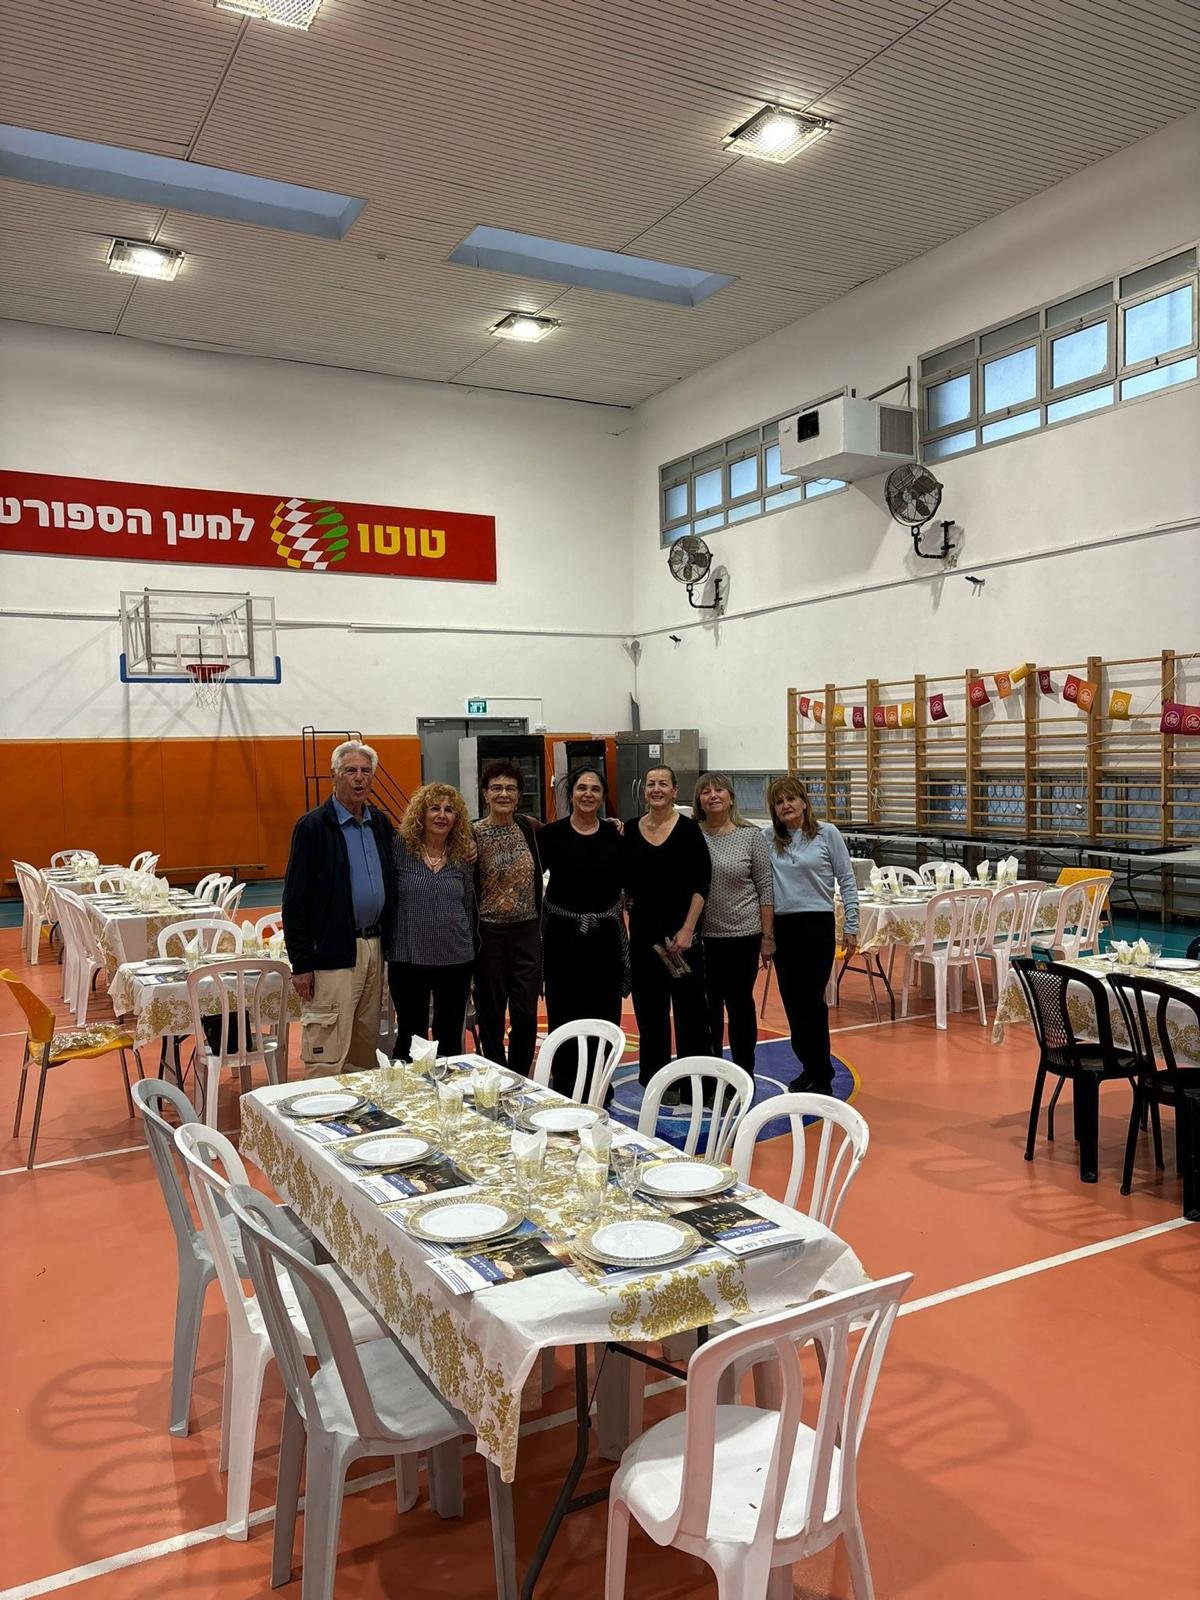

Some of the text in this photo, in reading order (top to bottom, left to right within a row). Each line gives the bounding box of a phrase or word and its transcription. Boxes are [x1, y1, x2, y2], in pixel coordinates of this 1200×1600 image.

[0, 496, 446, 559] טוטו למען הספורט
